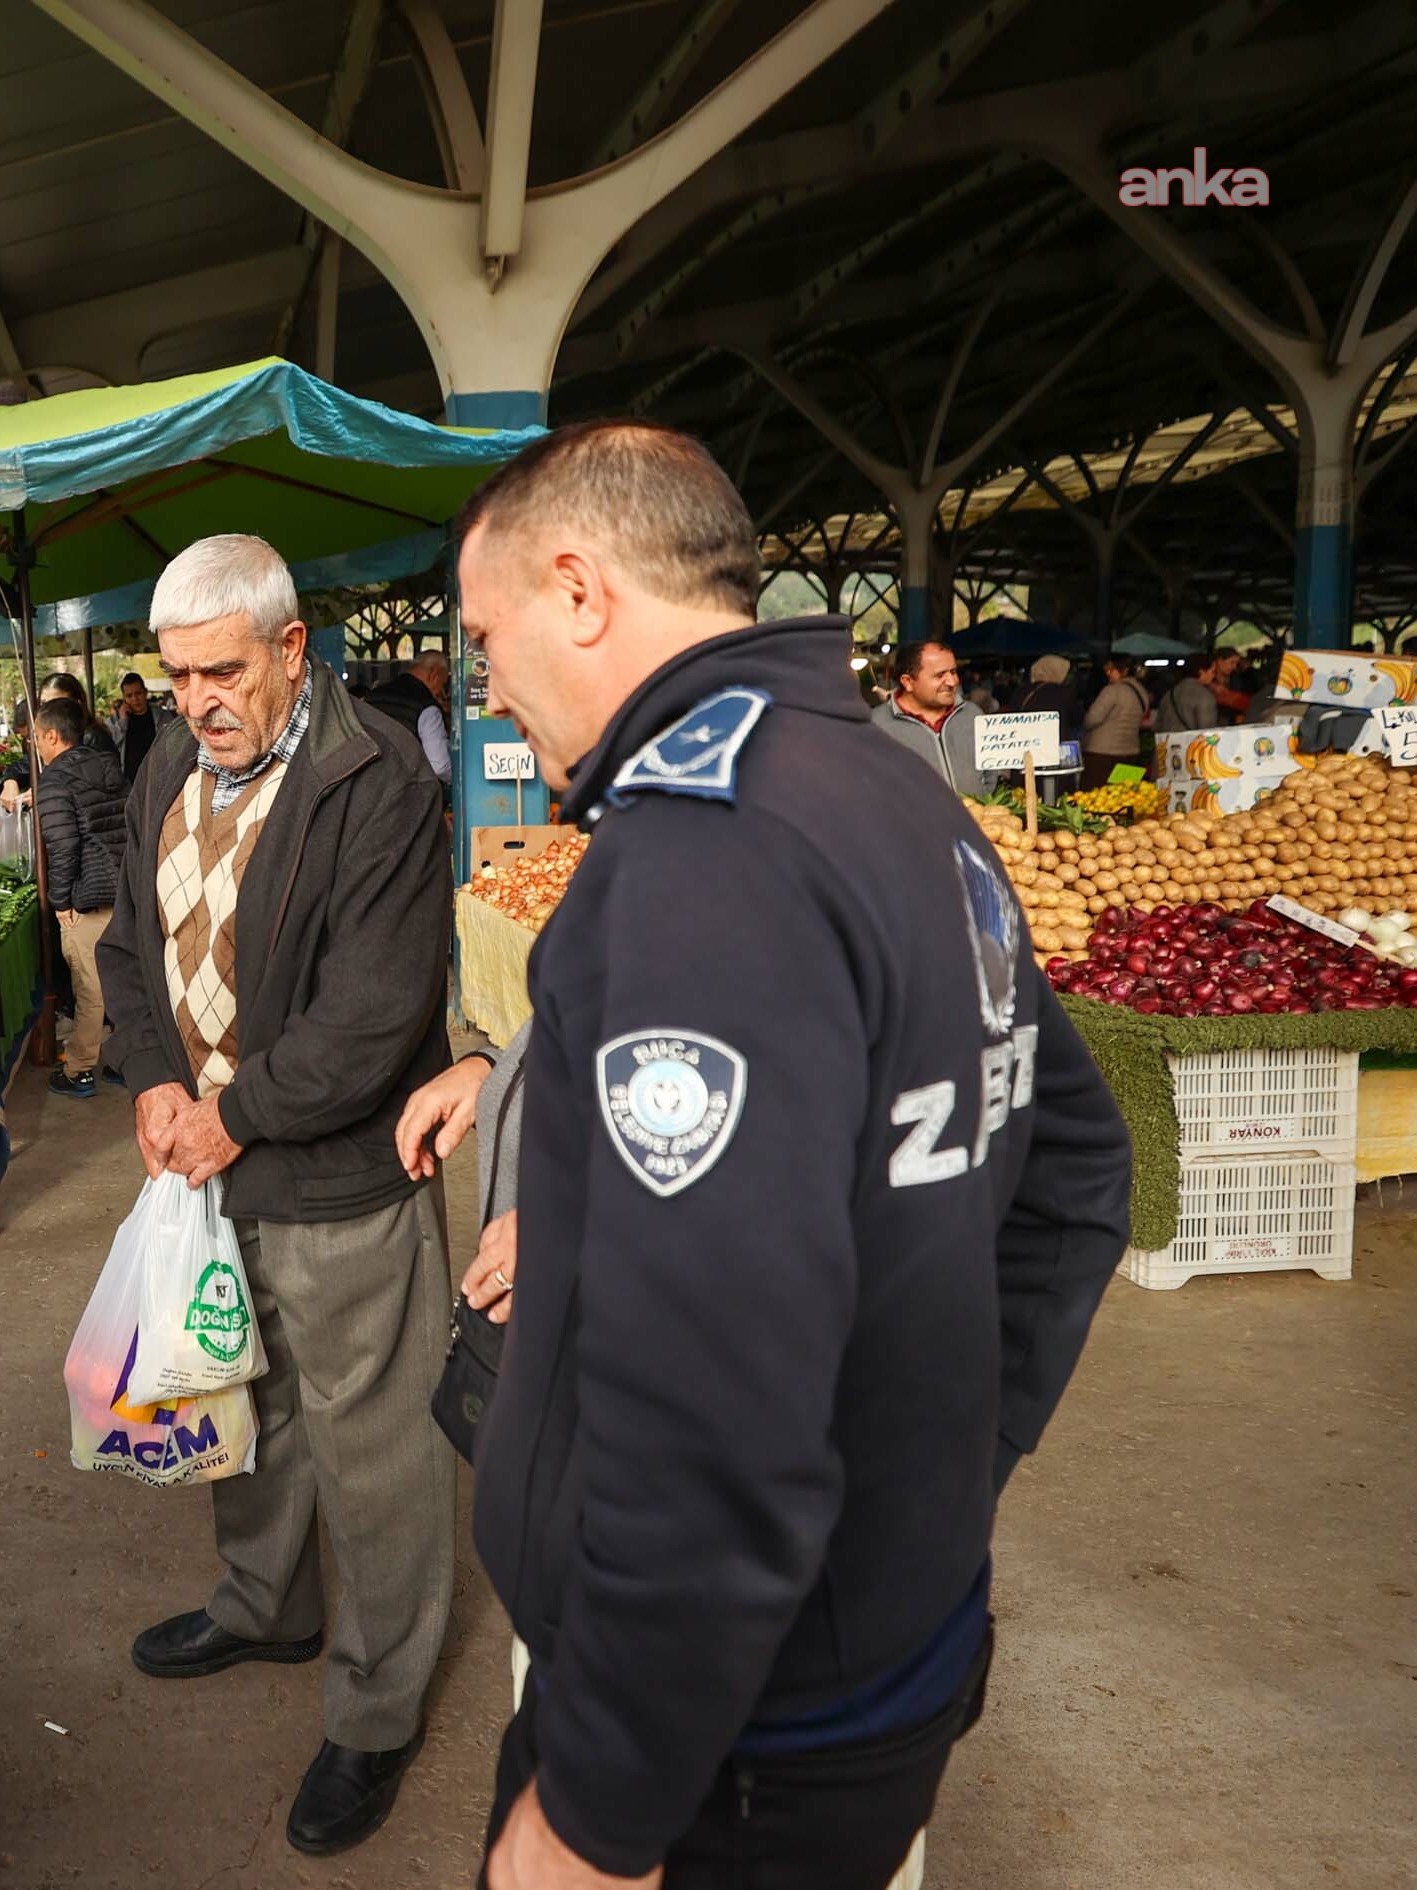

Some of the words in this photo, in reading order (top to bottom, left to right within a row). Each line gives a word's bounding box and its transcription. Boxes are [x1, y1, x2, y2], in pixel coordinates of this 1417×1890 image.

[981, 739, 1041, 752] PATATES
[1229, 1126, 1280, 1139] KONYAR
[96, 1413, 220, 1470] ACEM
